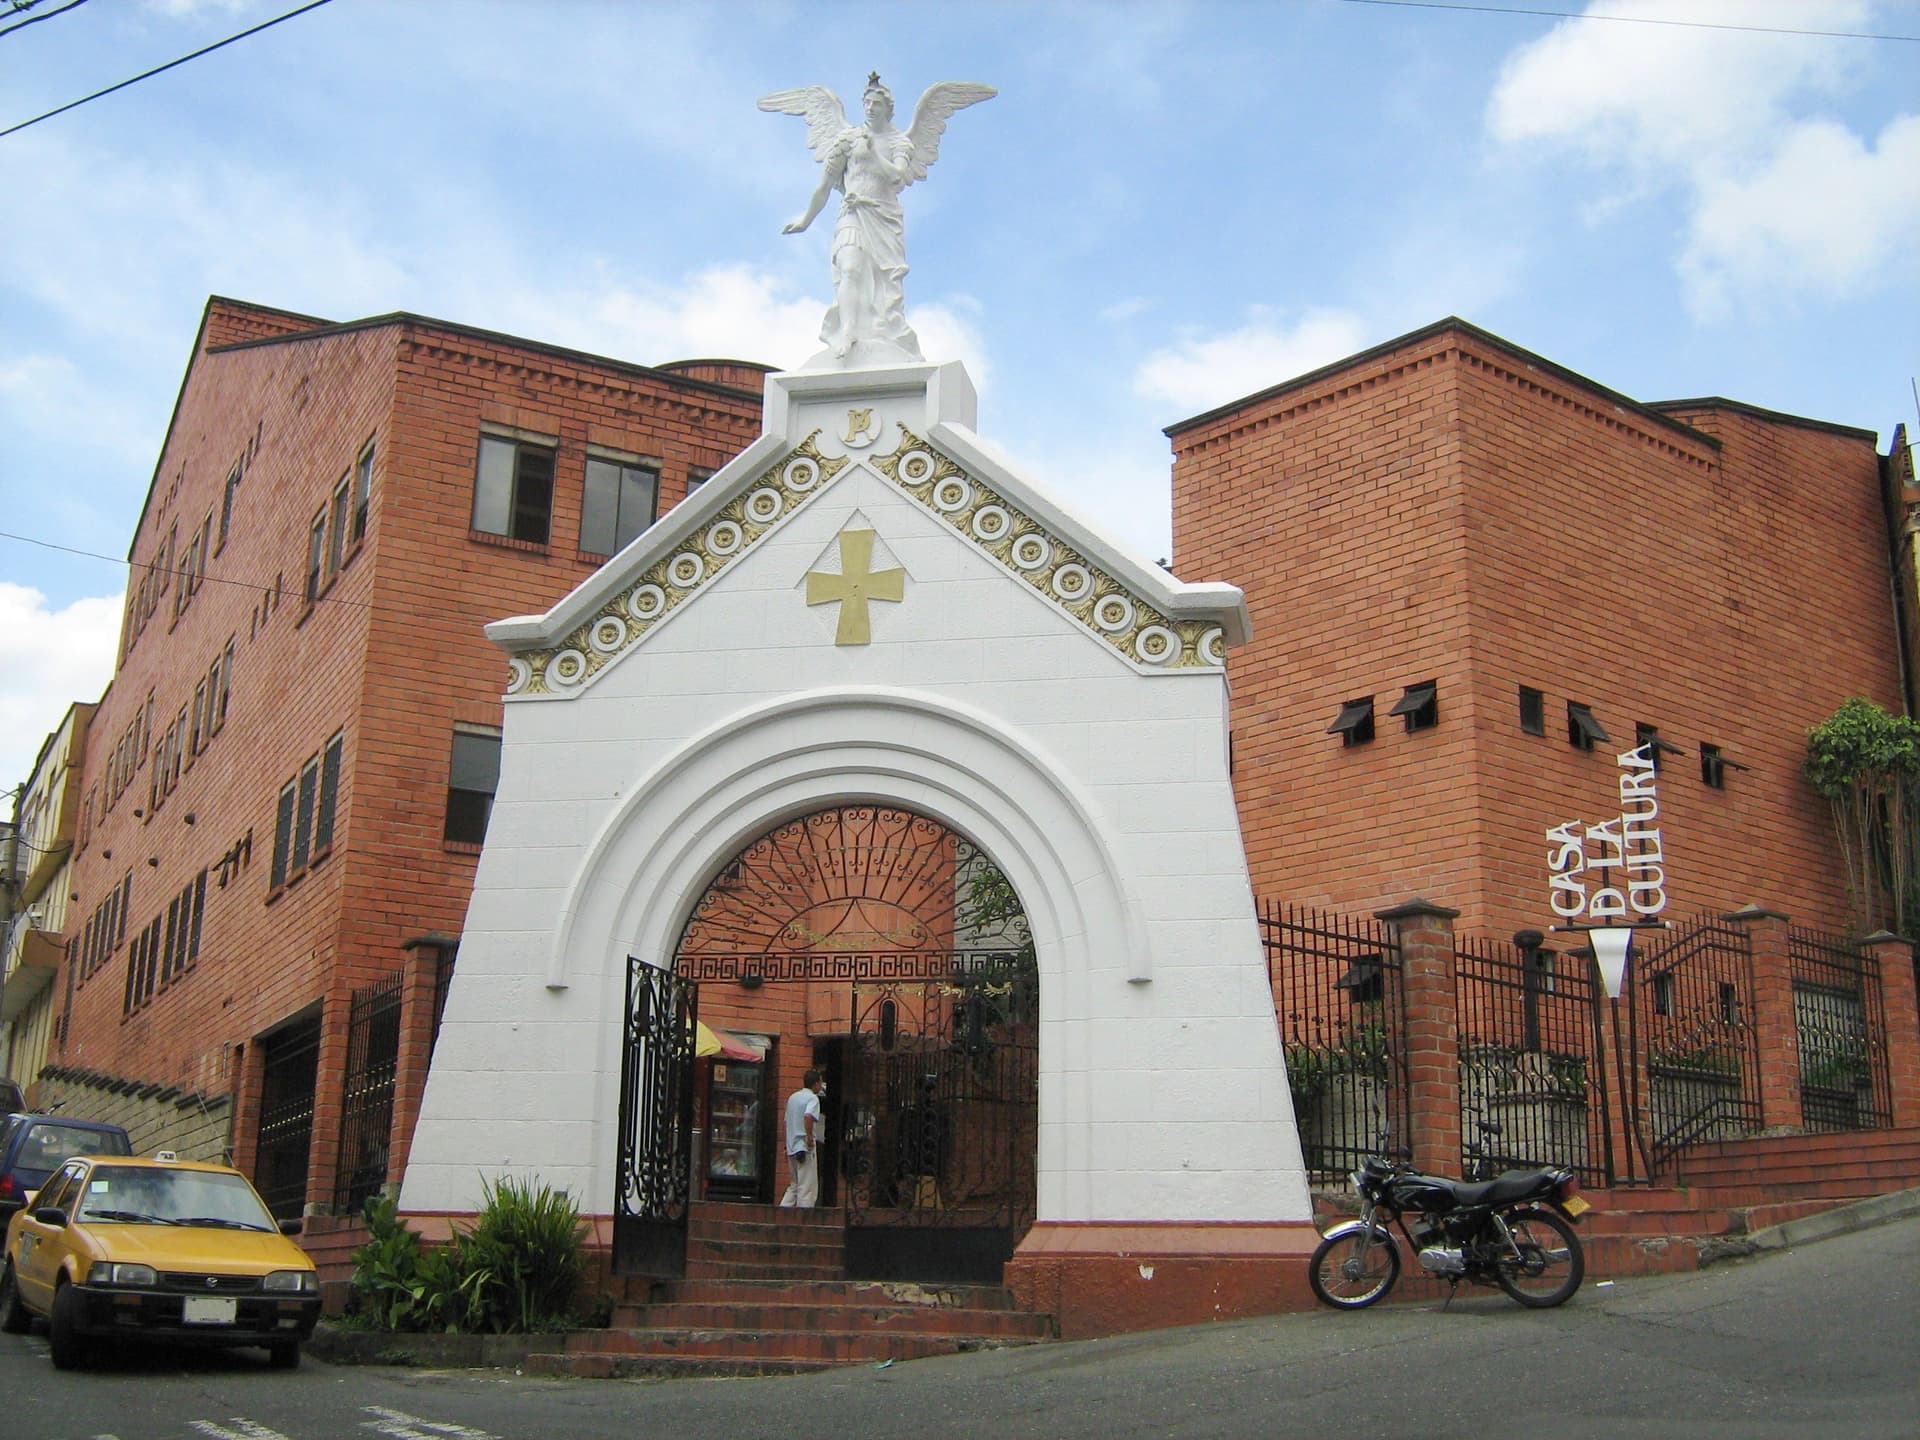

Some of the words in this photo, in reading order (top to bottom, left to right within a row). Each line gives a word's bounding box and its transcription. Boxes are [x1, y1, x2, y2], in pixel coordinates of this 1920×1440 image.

[1546, 818, 1586, 917] CASA
[1586, 817, 1624, 868] LA
[1616, 742, 1666, 914] CULTURA
